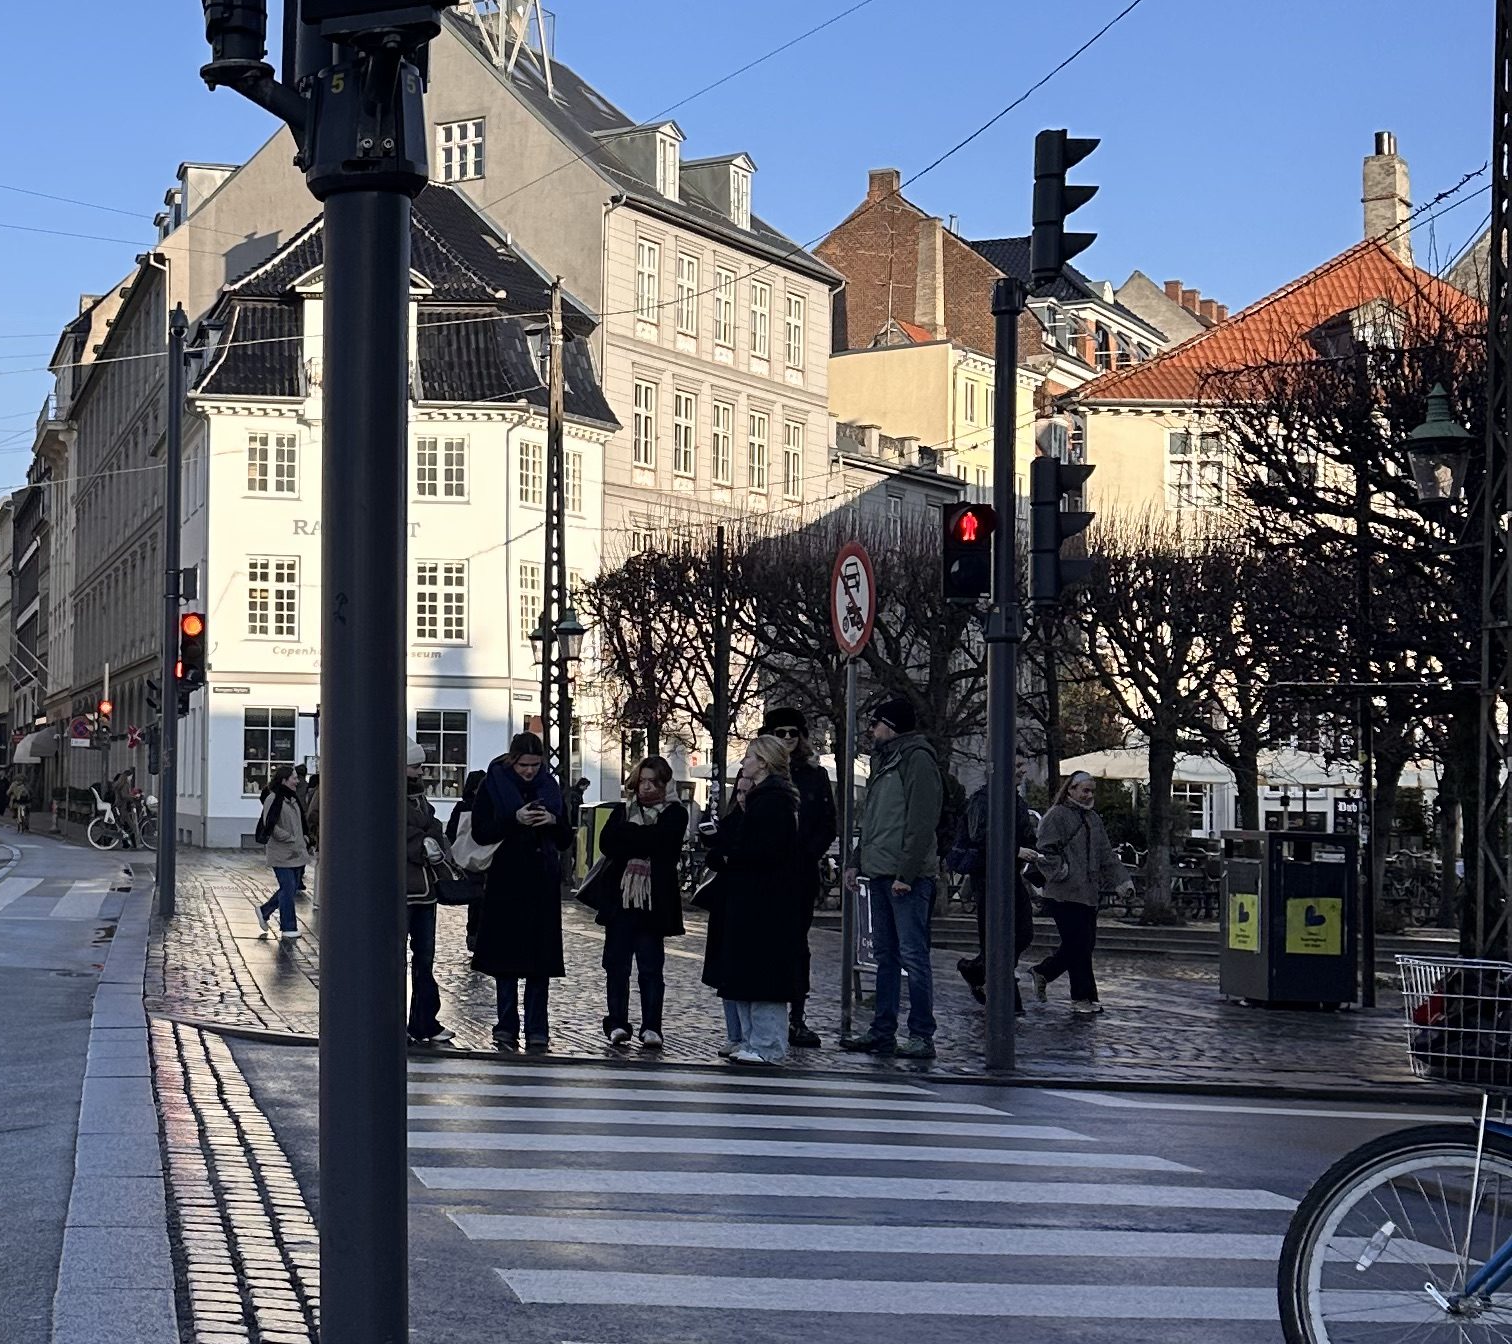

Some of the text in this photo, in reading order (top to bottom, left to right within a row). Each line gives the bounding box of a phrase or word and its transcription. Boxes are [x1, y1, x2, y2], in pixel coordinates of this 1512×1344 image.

[331, 72, 345, 94] 5
[407, 74, 417, 94] 5
[272, 646, 322, 657] Copenh
